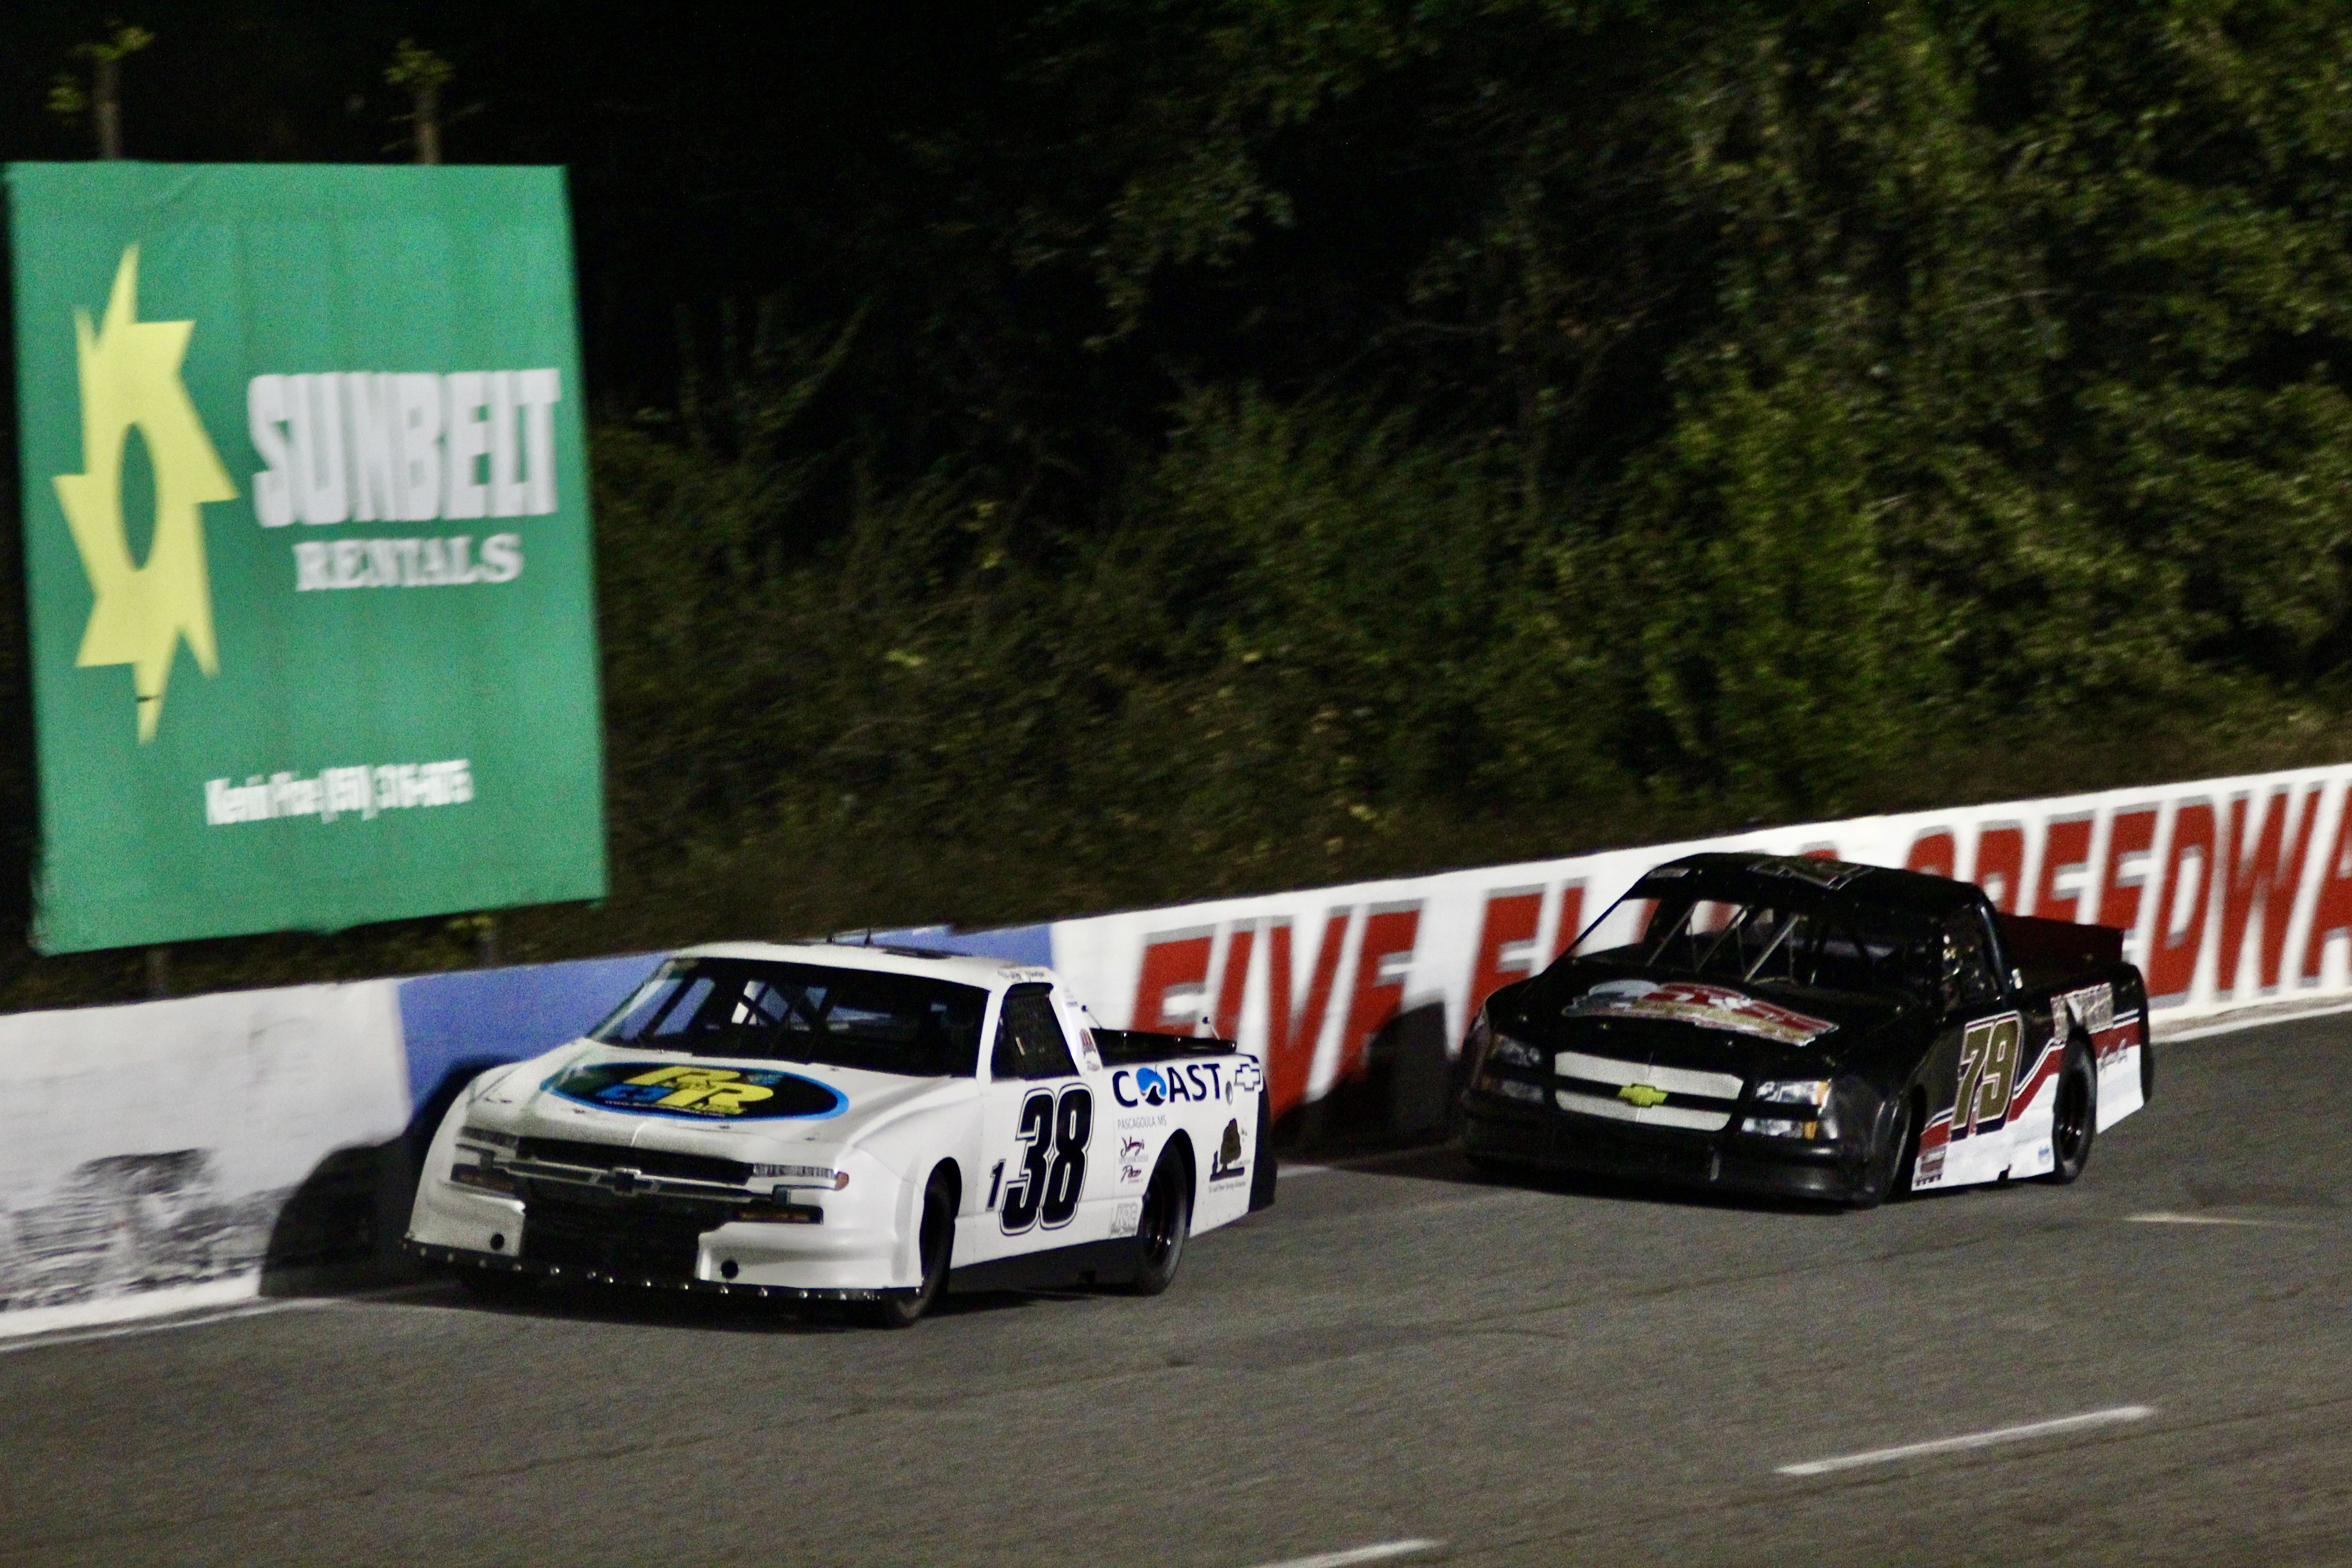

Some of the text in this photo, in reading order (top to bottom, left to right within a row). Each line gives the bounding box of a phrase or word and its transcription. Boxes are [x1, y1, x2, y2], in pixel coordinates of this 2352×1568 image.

[248, 368, 560, 528] SUNBELT
[293, 534, 523, 592] RENTALS
[1127, 898, 1428, 1123] FIVE
[1949, 1010, 2024, 1142] 79
[1112, 1063, 1220, 1107] COAST
[985, 1082, 1095, 1237] 1 38
